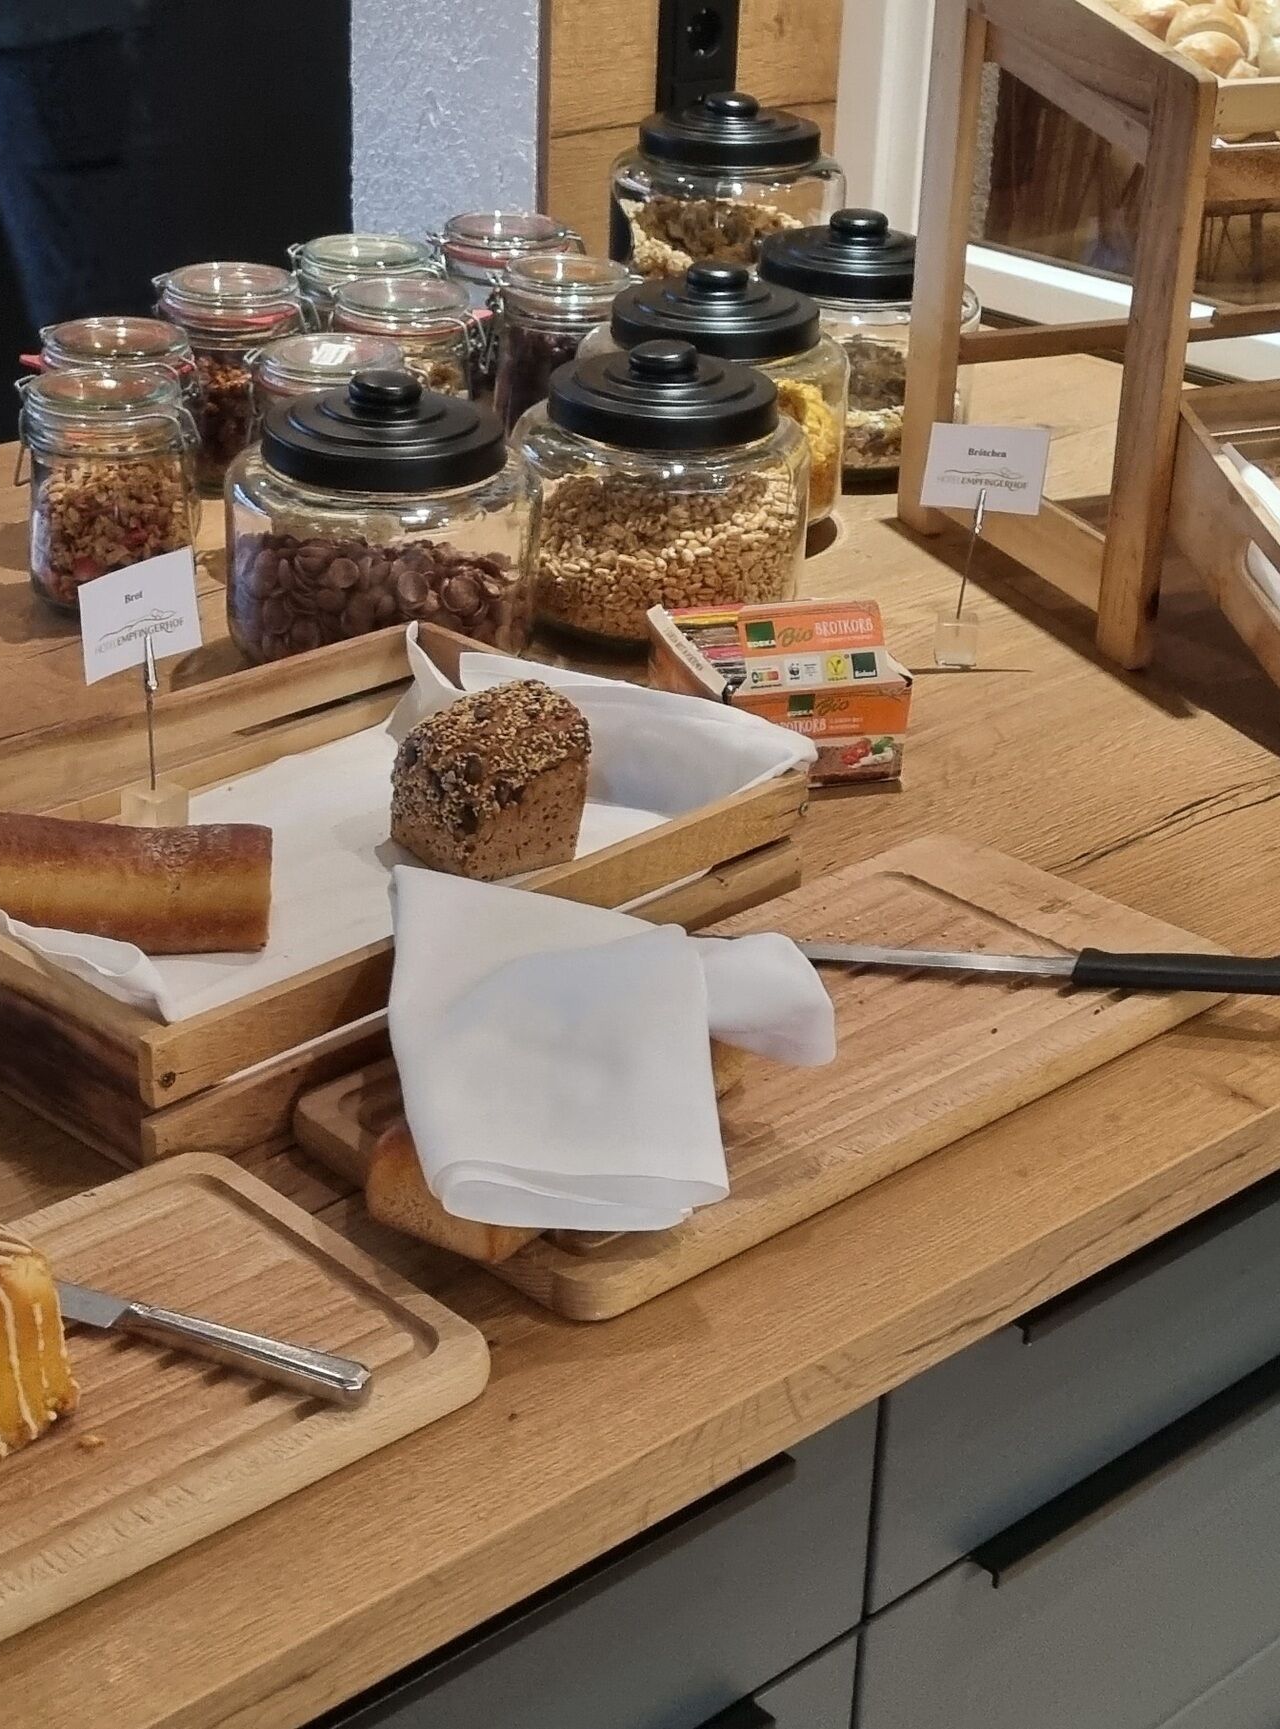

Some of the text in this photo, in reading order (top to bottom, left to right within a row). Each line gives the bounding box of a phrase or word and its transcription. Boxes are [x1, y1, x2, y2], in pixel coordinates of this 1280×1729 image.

[124, 590, 144, 604] Brot
[778, 627, 814, 647] Bio
[815, 618, 874, 636] BROTKORB
[816, 697, 849, 716] Bio
[778, 717, 827, 732] OTKORB
